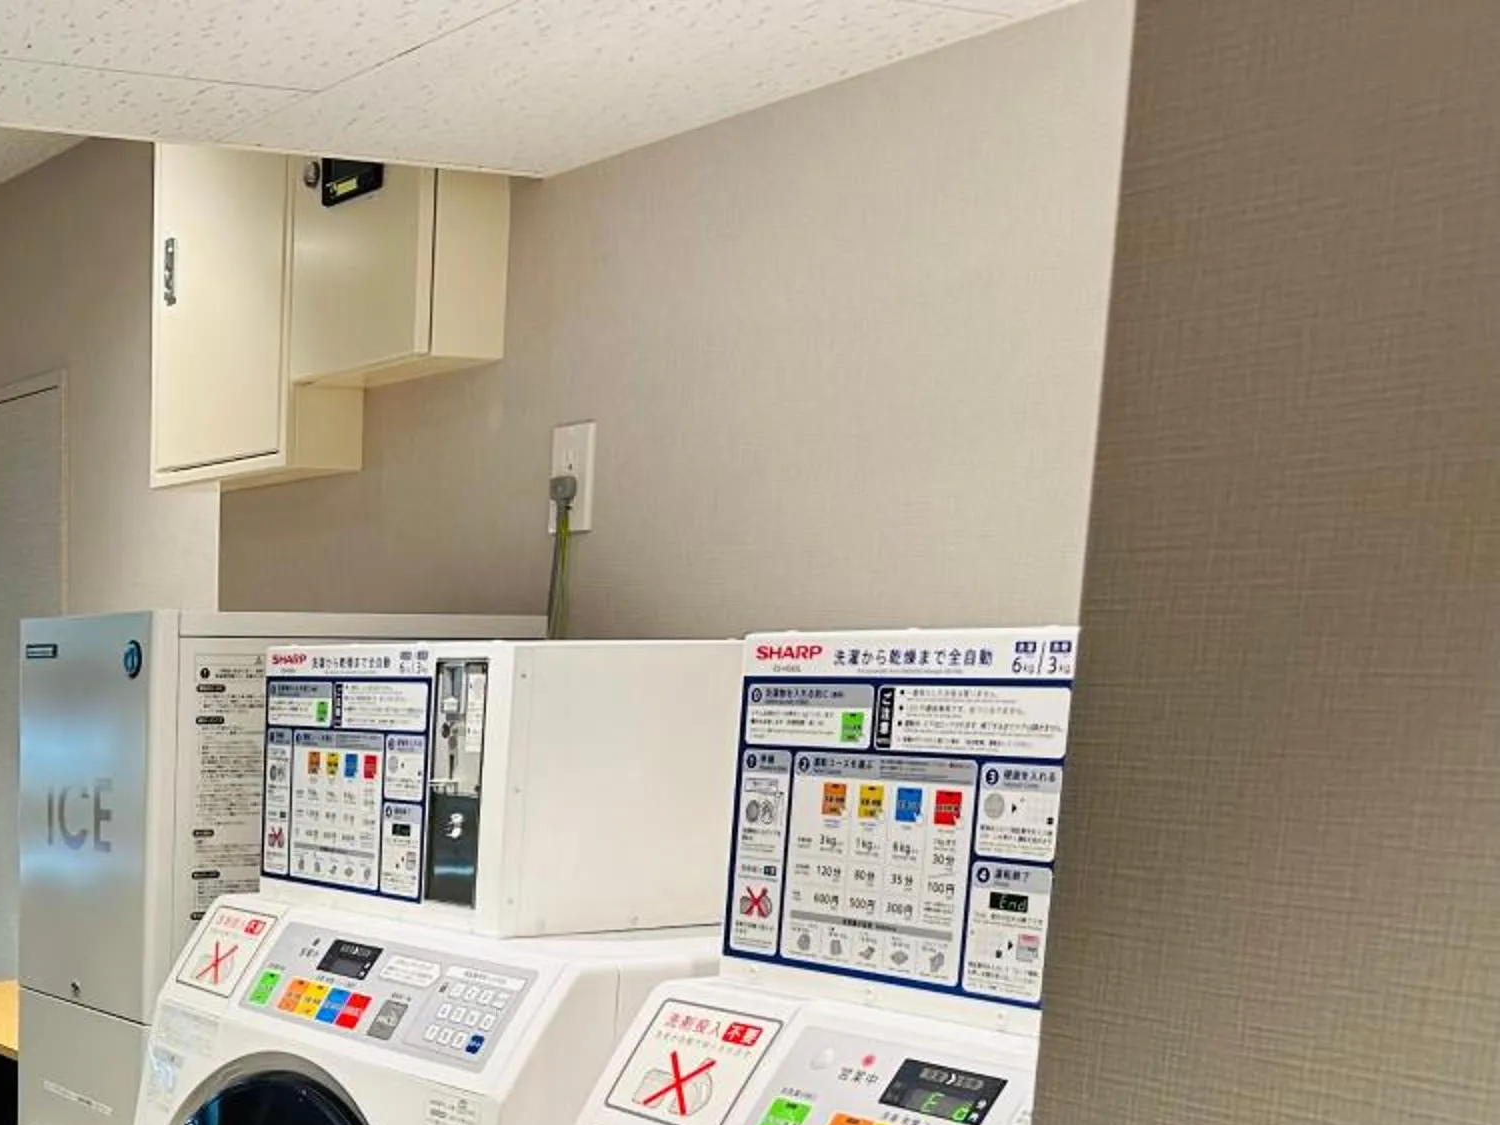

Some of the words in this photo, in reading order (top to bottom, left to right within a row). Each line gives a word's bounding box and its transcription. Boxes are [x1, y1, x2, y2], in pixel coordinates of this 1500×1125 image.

[272, 652, 307, 666] SHARP
[755, 645, 823, 661] SHARP
[833, 648, 993, 667] 洗濯から乾燥まで全自動
[47, 778, 113, 853] ICE
[726, 1023, 761, 1044] 不要
[837, 1066, 879, 1085] 営業中
